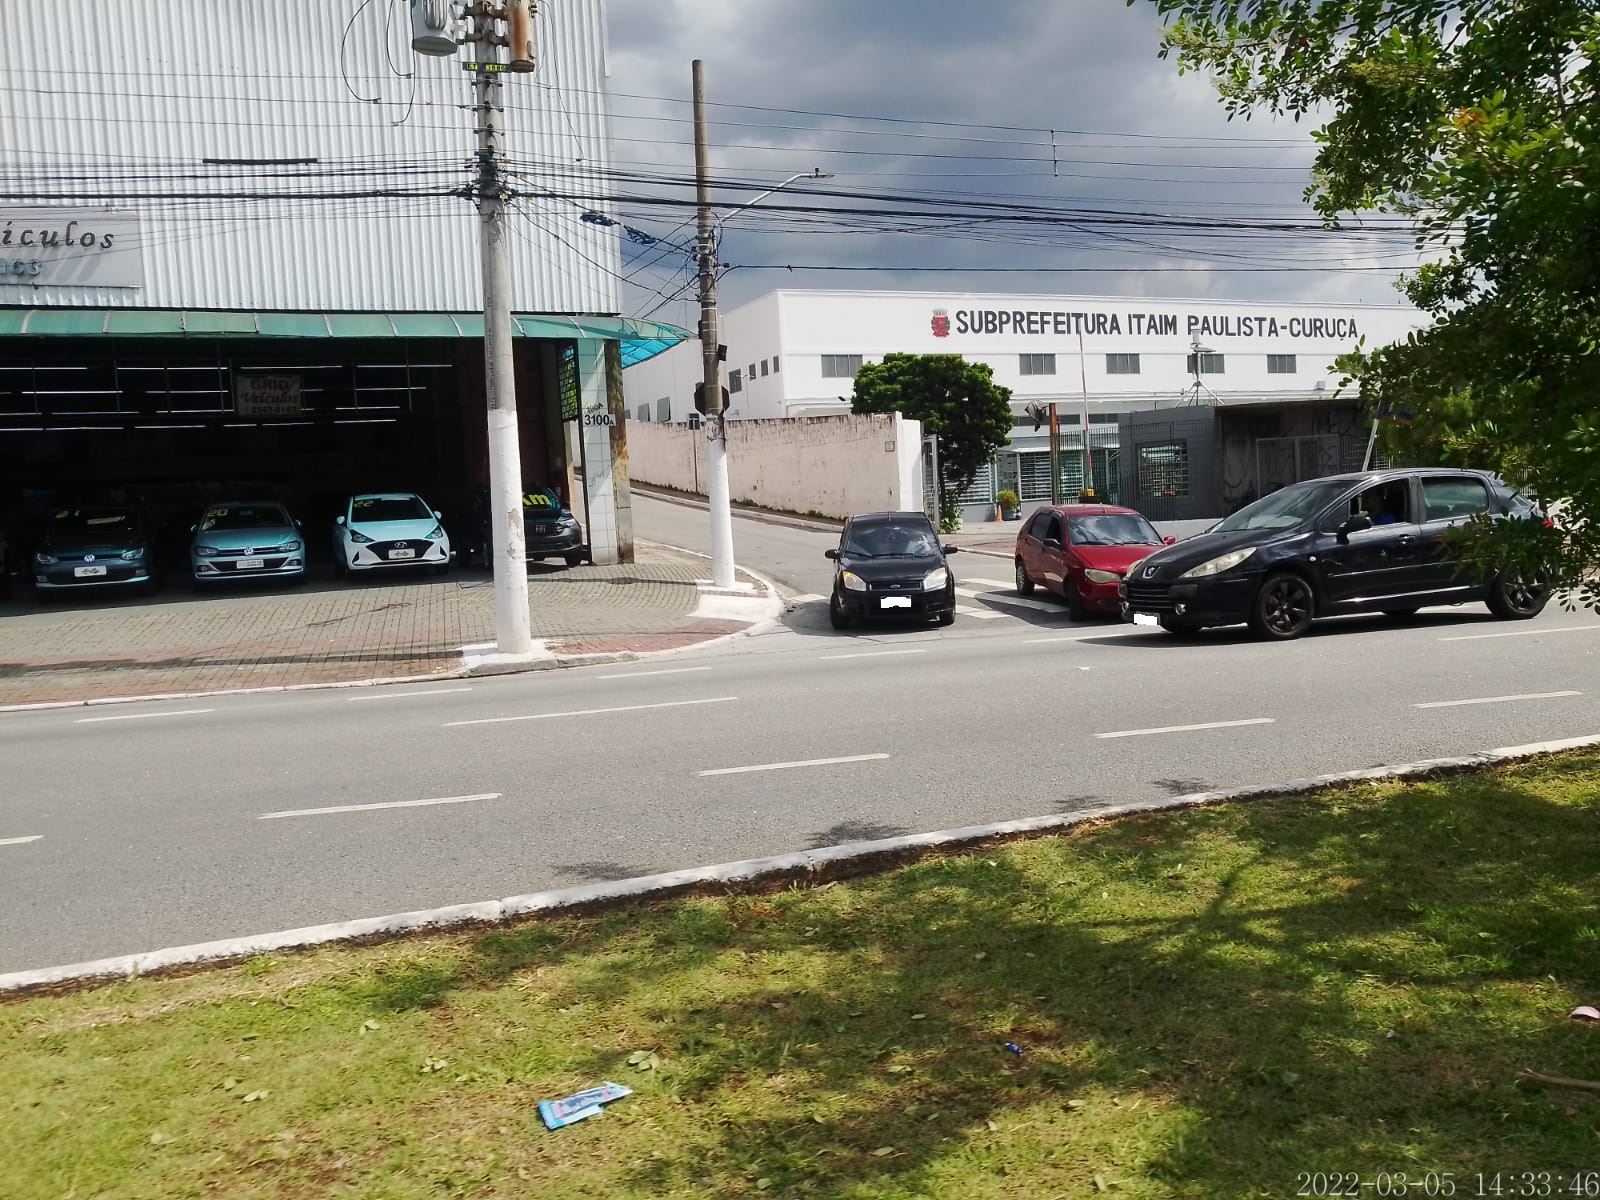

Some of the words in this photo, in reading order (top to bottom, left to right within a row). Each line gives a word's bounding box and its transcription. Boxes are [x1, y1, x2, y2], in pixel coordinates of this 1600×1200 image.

[956, 310, 1121, 335] SUBPREFEITURA
[1127, 313, 1177, 335] ITAIM
[250, 379, 289, 390] GRID
[241, 391, 298, 404] Veículos
